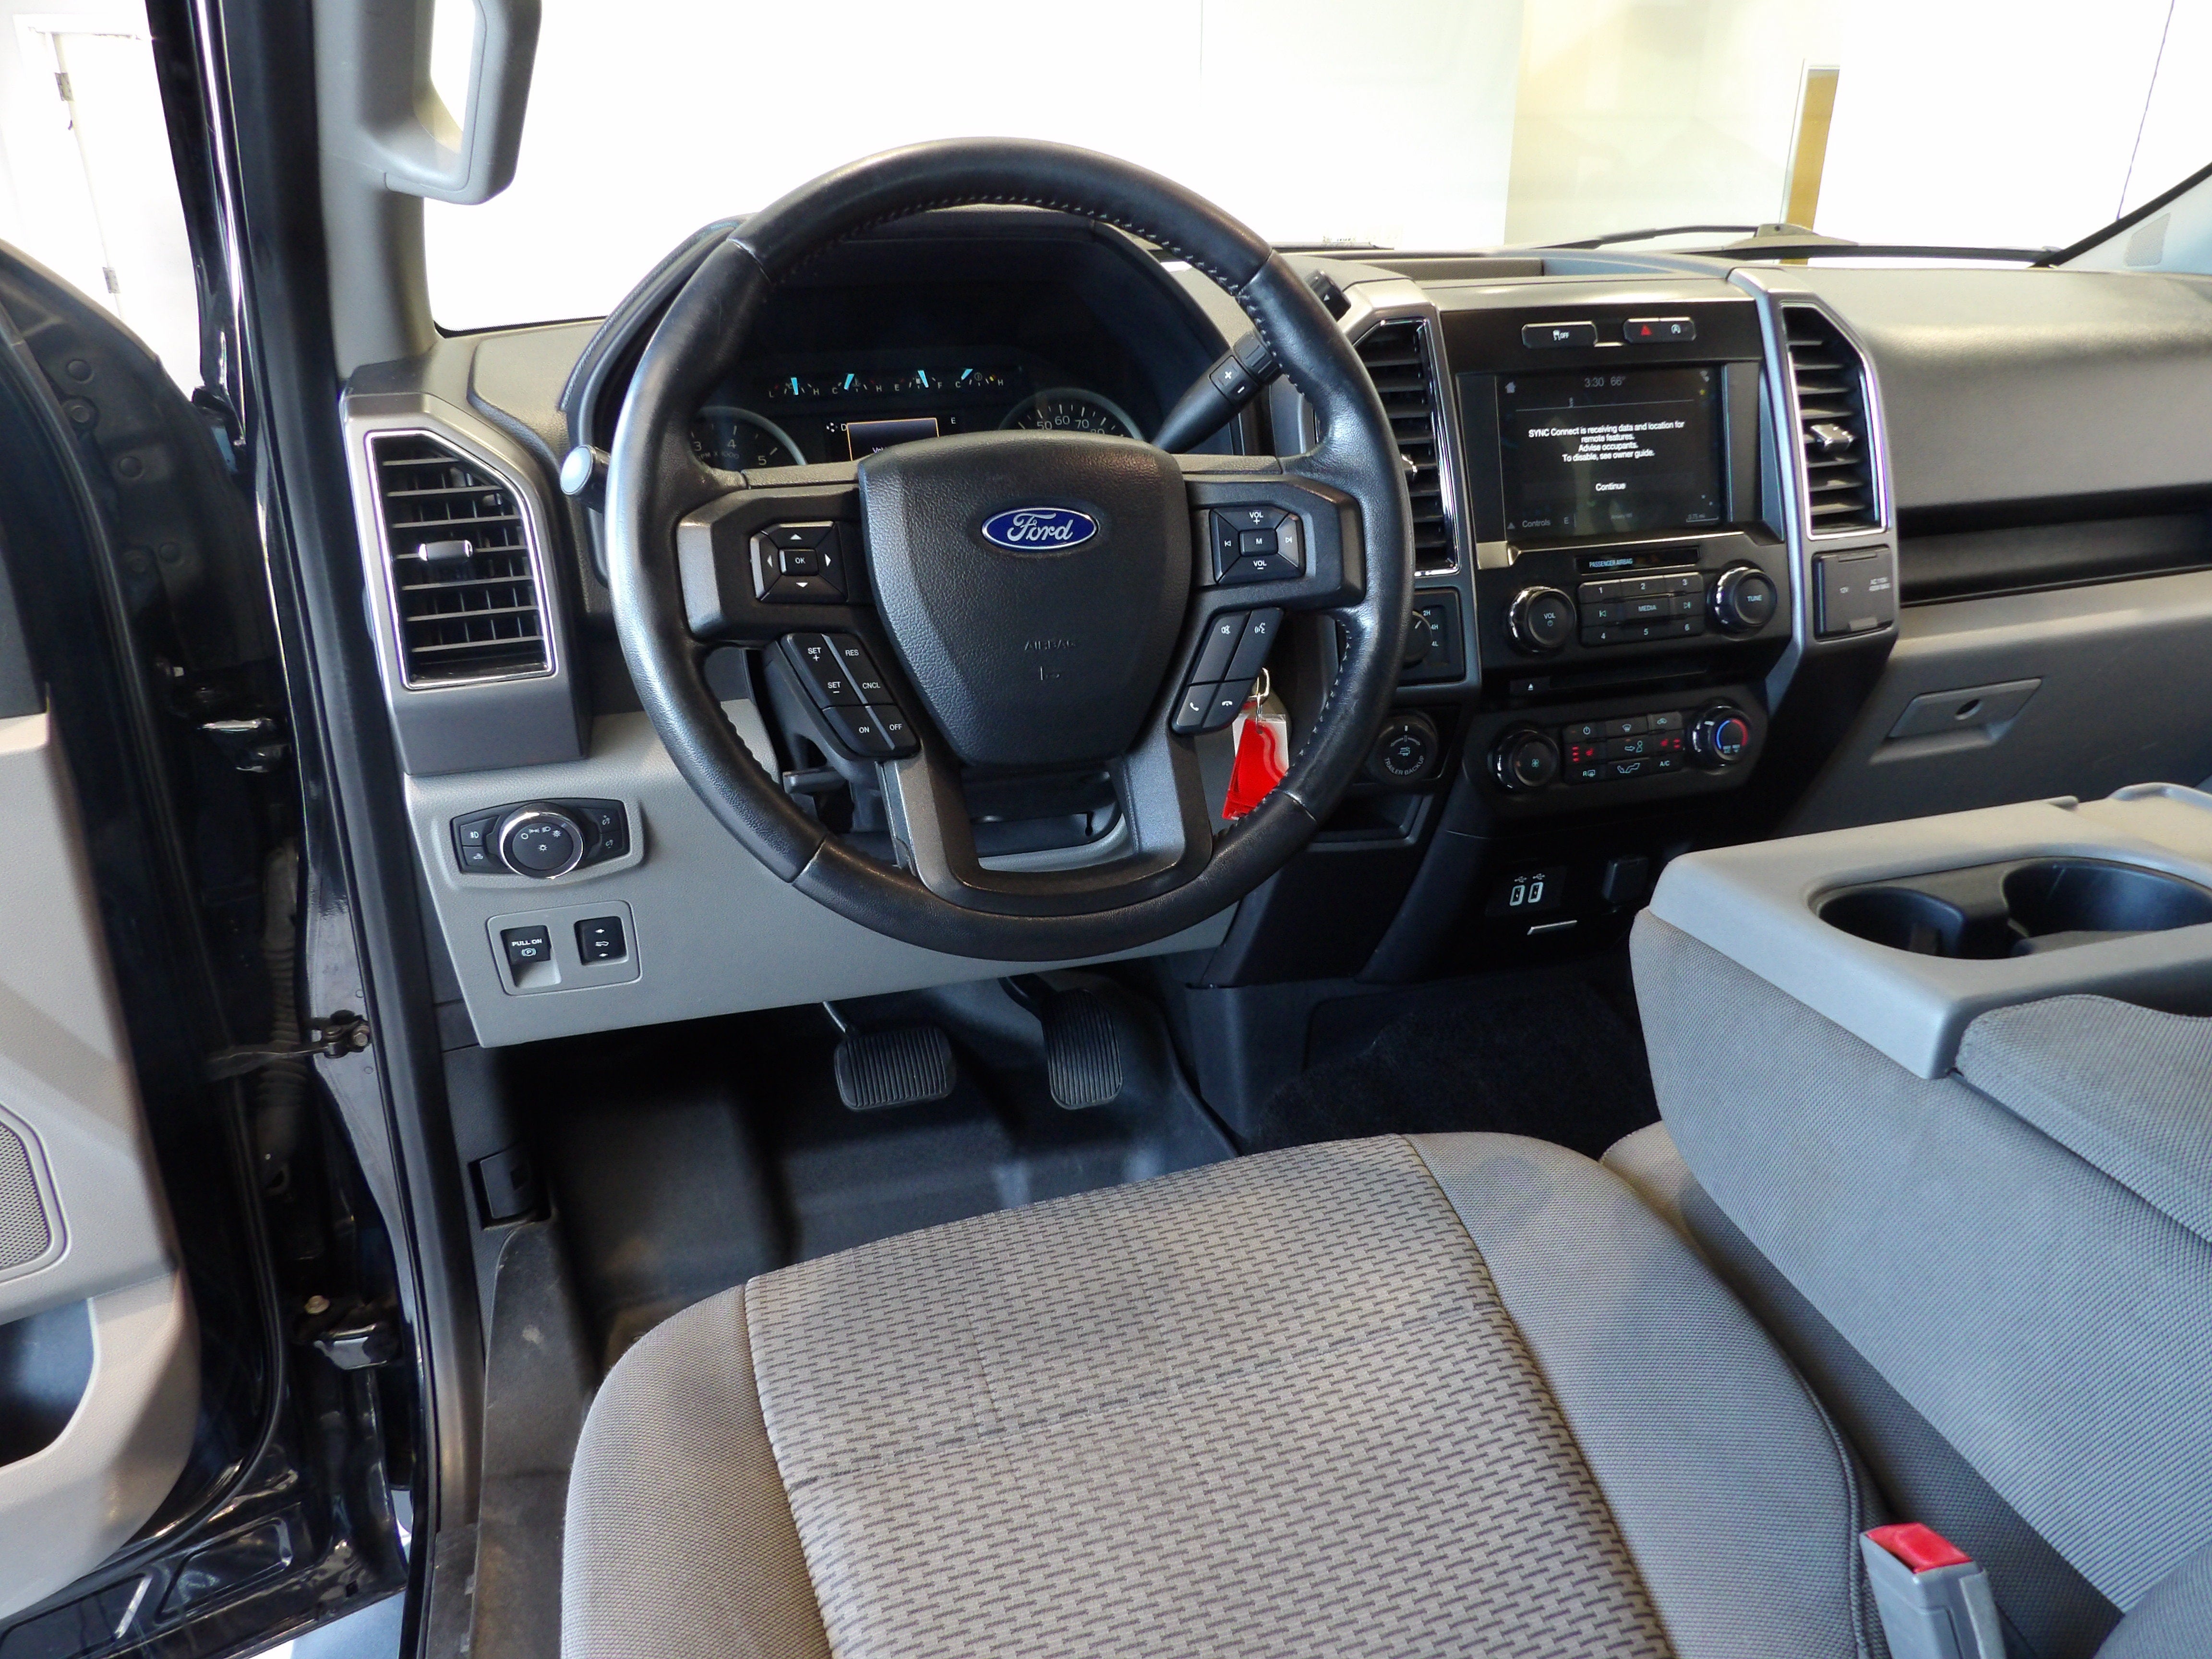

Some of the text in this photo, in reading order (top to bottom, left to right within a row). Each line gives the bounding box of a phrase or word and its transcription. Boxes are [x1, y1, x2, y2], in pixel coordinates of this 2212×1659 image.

[1585, 377, 1604, 387] 3:30
[1055, 415, 1070, 425] 60
[1075, 419, 1089, 429] 70
[1037, 421, 1052, 431] 50
[1528, 428, 1550, 437] SYNC
[1551, 427, 1580, 436] Connect
[1580, 426, 1587, 434] is
[1587, 425, 1617, 434] receiving
[1618, 423, 1633, 433] data
[1634, 423, 1647, 432] and
[1648, 421, 1674, 431] location
[1606, 433, 1635, 441] features.
[694, 441, 702, 451] 3
[727, 439, 736, 449] 4
[1578, 442, 1638, 452] Advise occupants.
[1562, 454, 1572, 462] To
[1573, 452, 1599, 461] disable,
[1613, 451, 1634, 459] owner
[1635, 449, 1655, 458] guide.
[758, 456, 767, 466] 5
[1596, 482, 1626, 491] Continue
[1007, 513, 1073, 542] Ford
[1522, 518, 1551, 528] Controls
[1638, 604, 1657, 612] MEDIA
[890, 723, 902, 732] OFF
[1384, 757, 1403, 775] TRAILER
